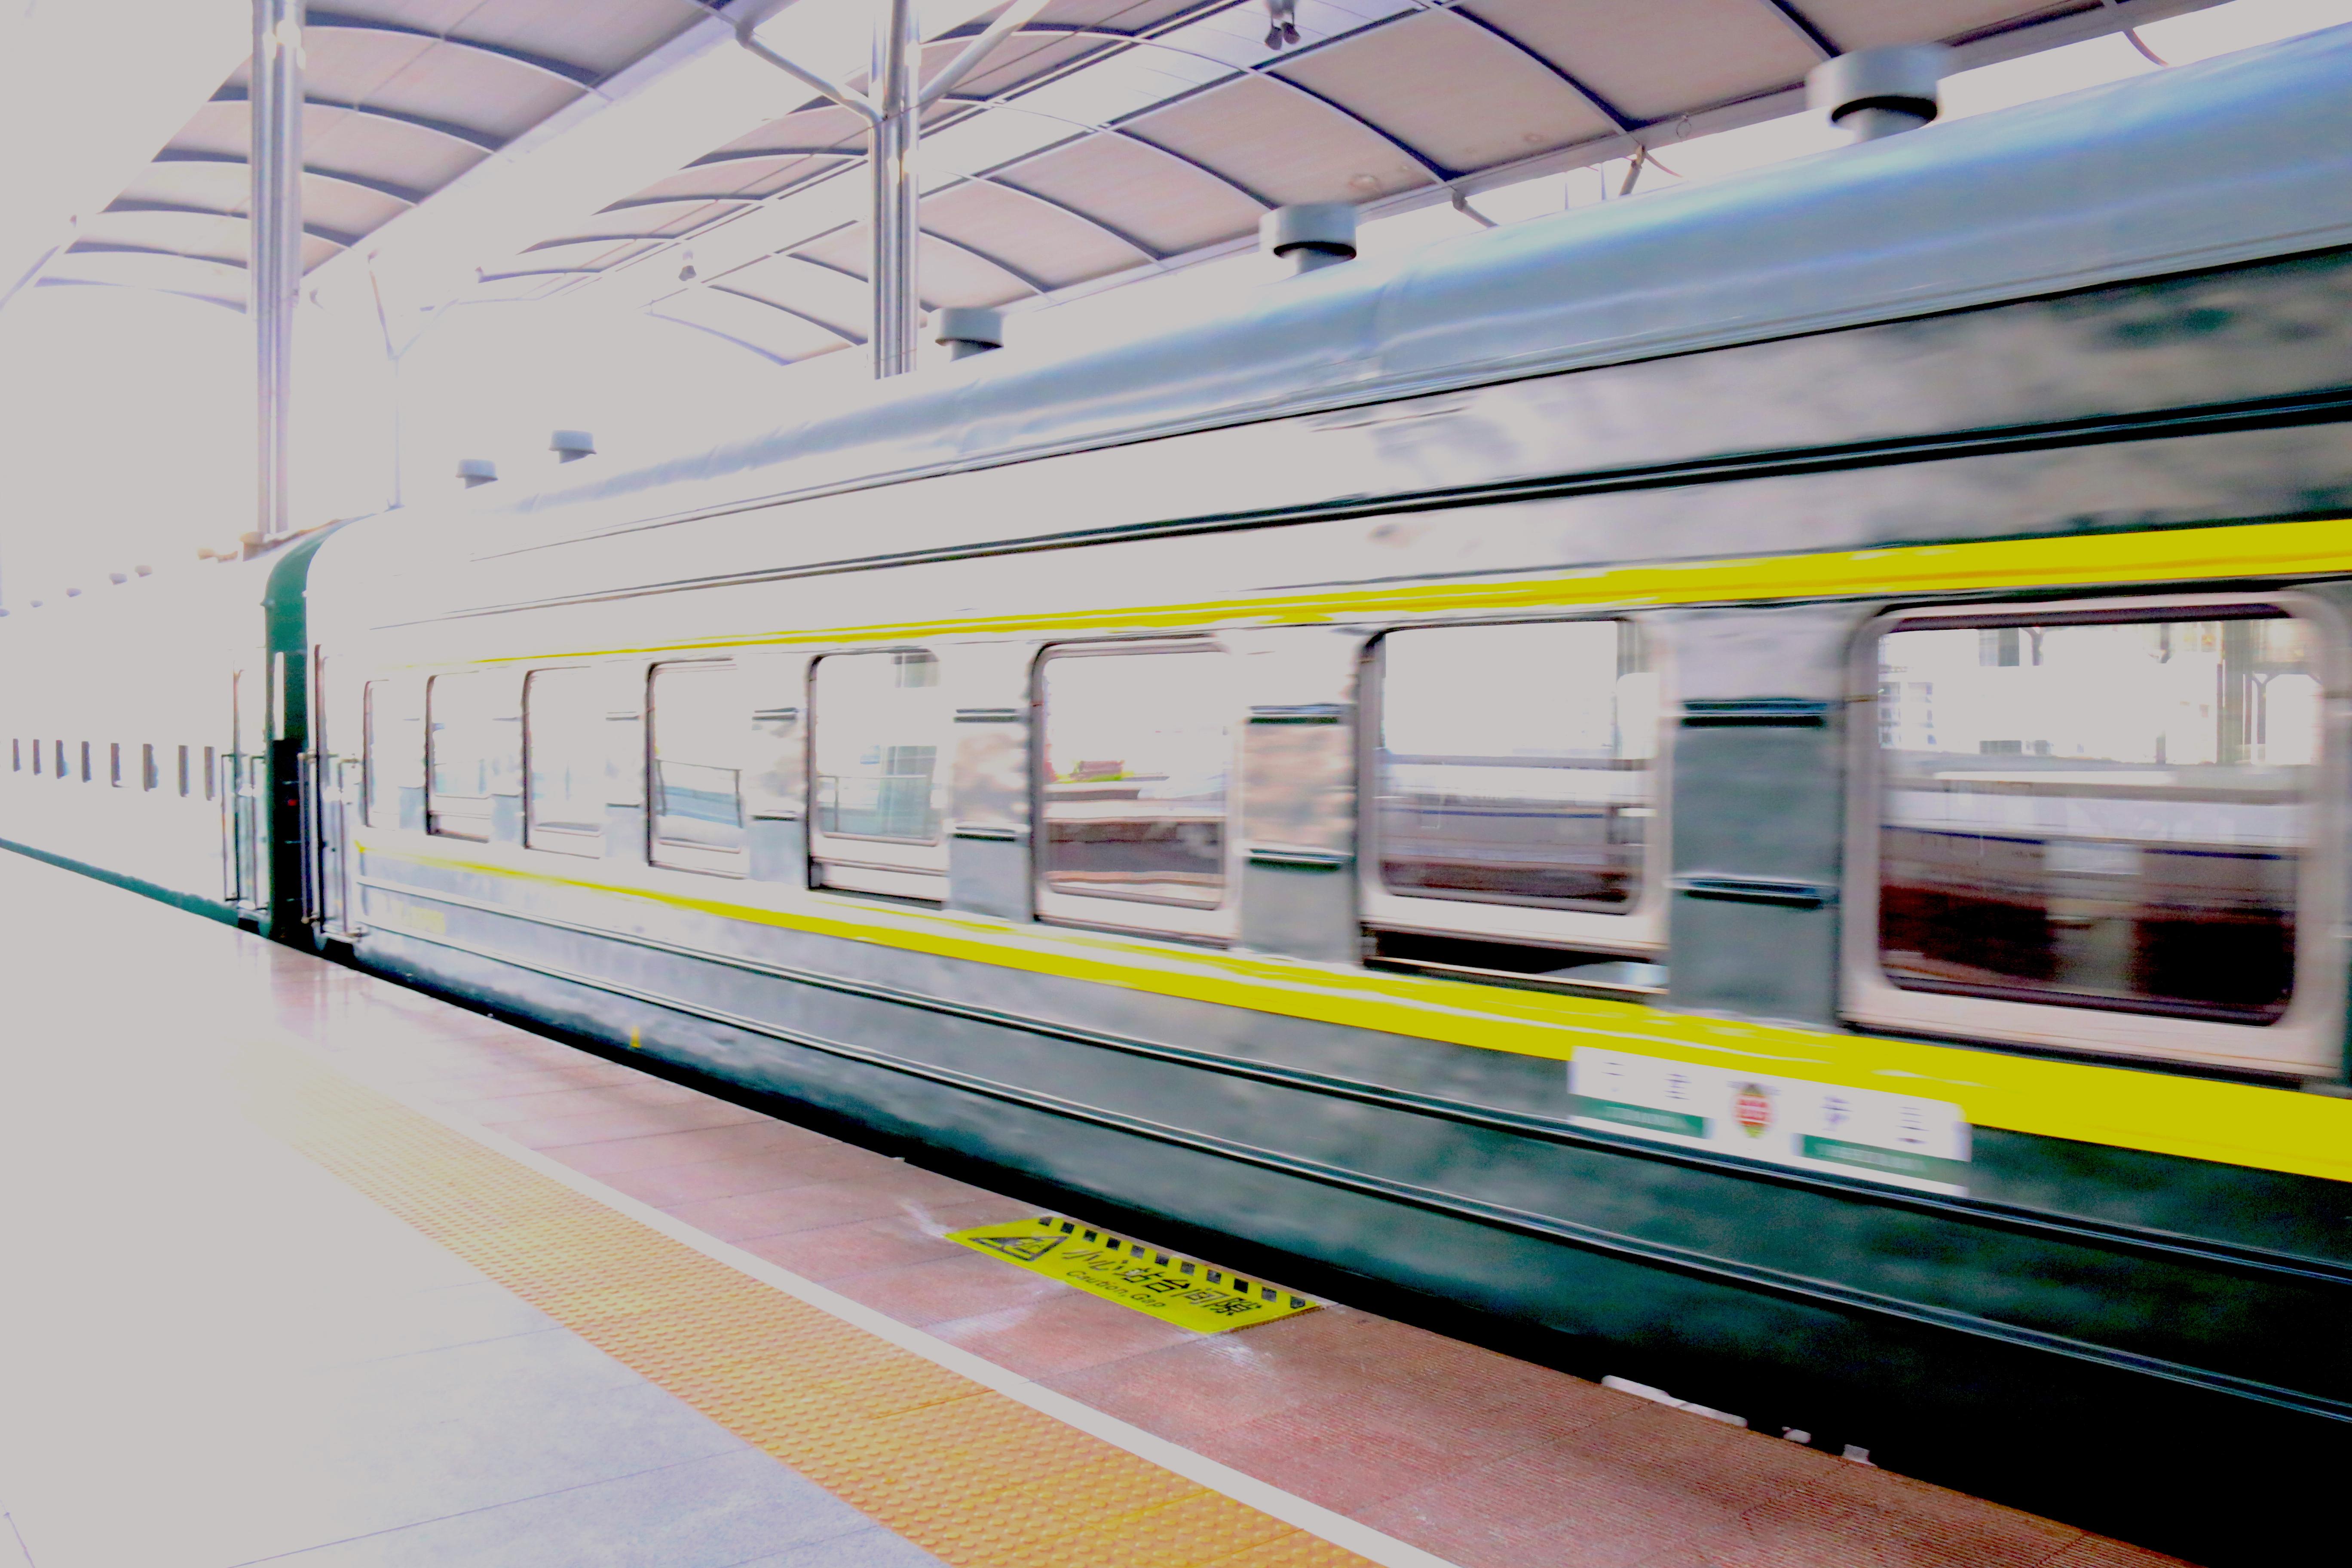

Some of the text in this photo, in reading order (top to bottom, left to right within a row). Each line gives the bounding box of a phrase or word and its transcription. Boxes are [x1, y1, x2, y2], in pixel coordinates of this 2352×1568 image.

[1062, 1250, 1262, 1316] 小心站台间隙
[1130, 1293, 1166, 1307] Gap
